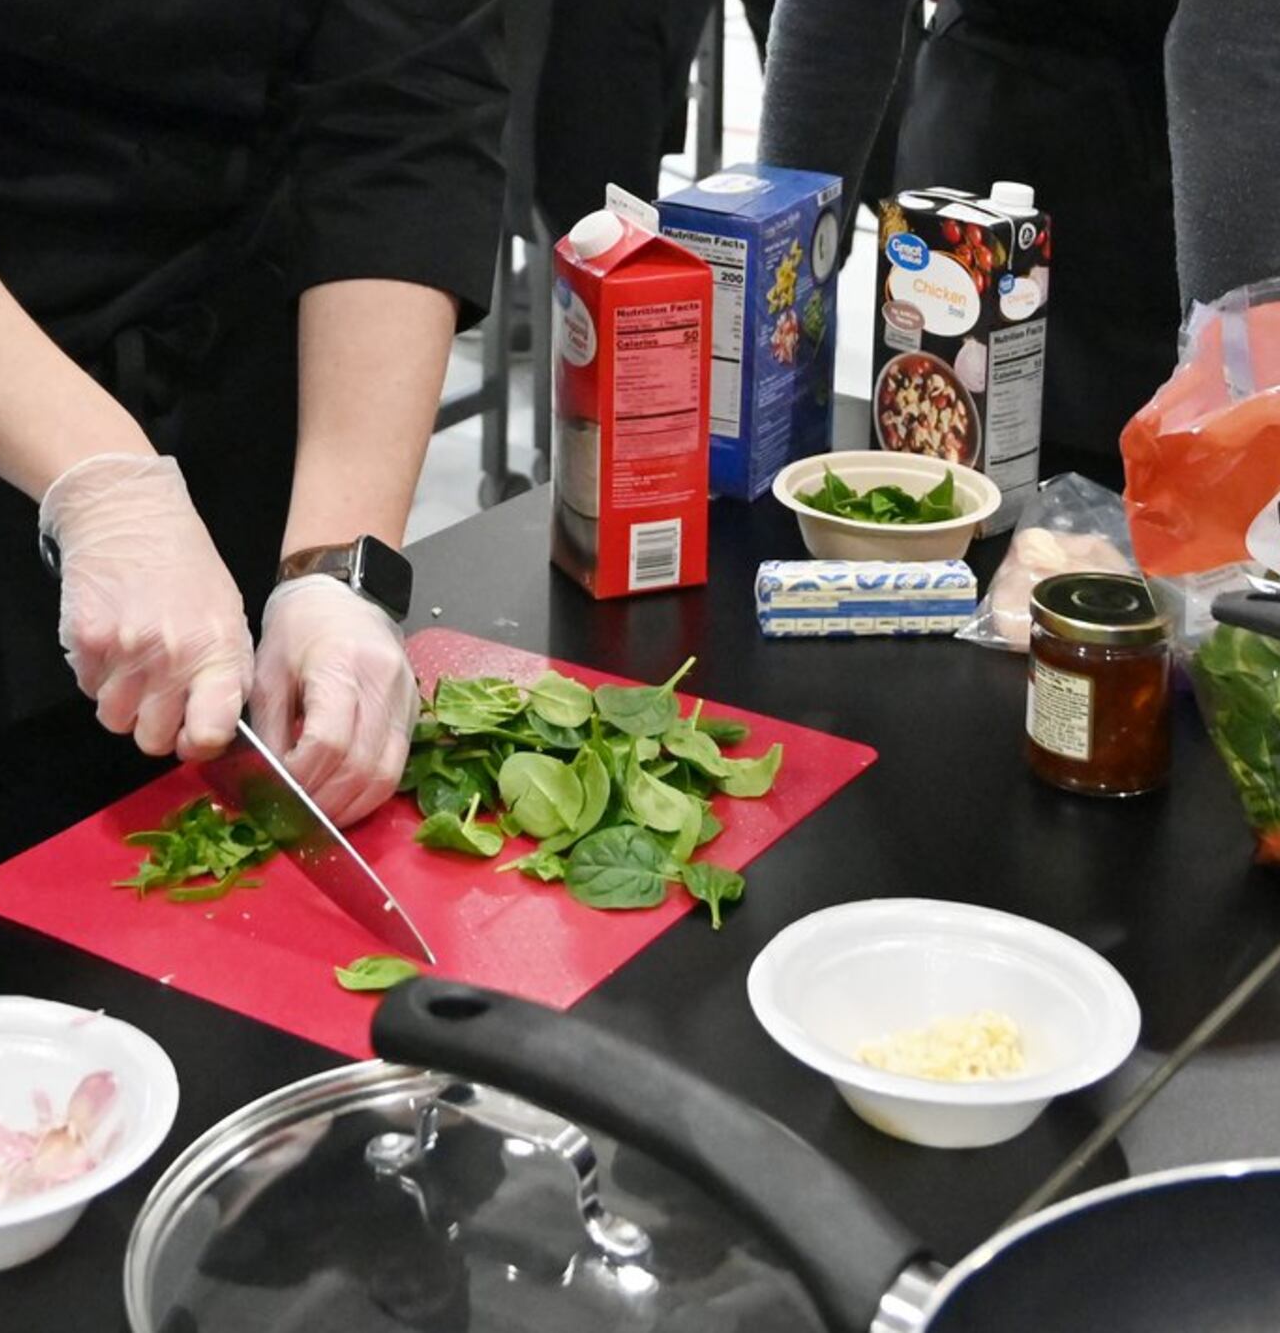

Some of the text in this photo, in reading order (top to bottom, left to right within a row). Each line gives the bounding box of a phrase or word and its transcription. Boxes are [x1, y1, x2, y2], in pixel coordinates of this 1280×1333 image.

[664, 228, 712, 244] Nutrition
[714, 237, 746, 250] Facts
[721, 272, 744, 284] 200
[616, 303, 700, 318] Nutrition Facts
[616, 339, 659, 350] Calories
